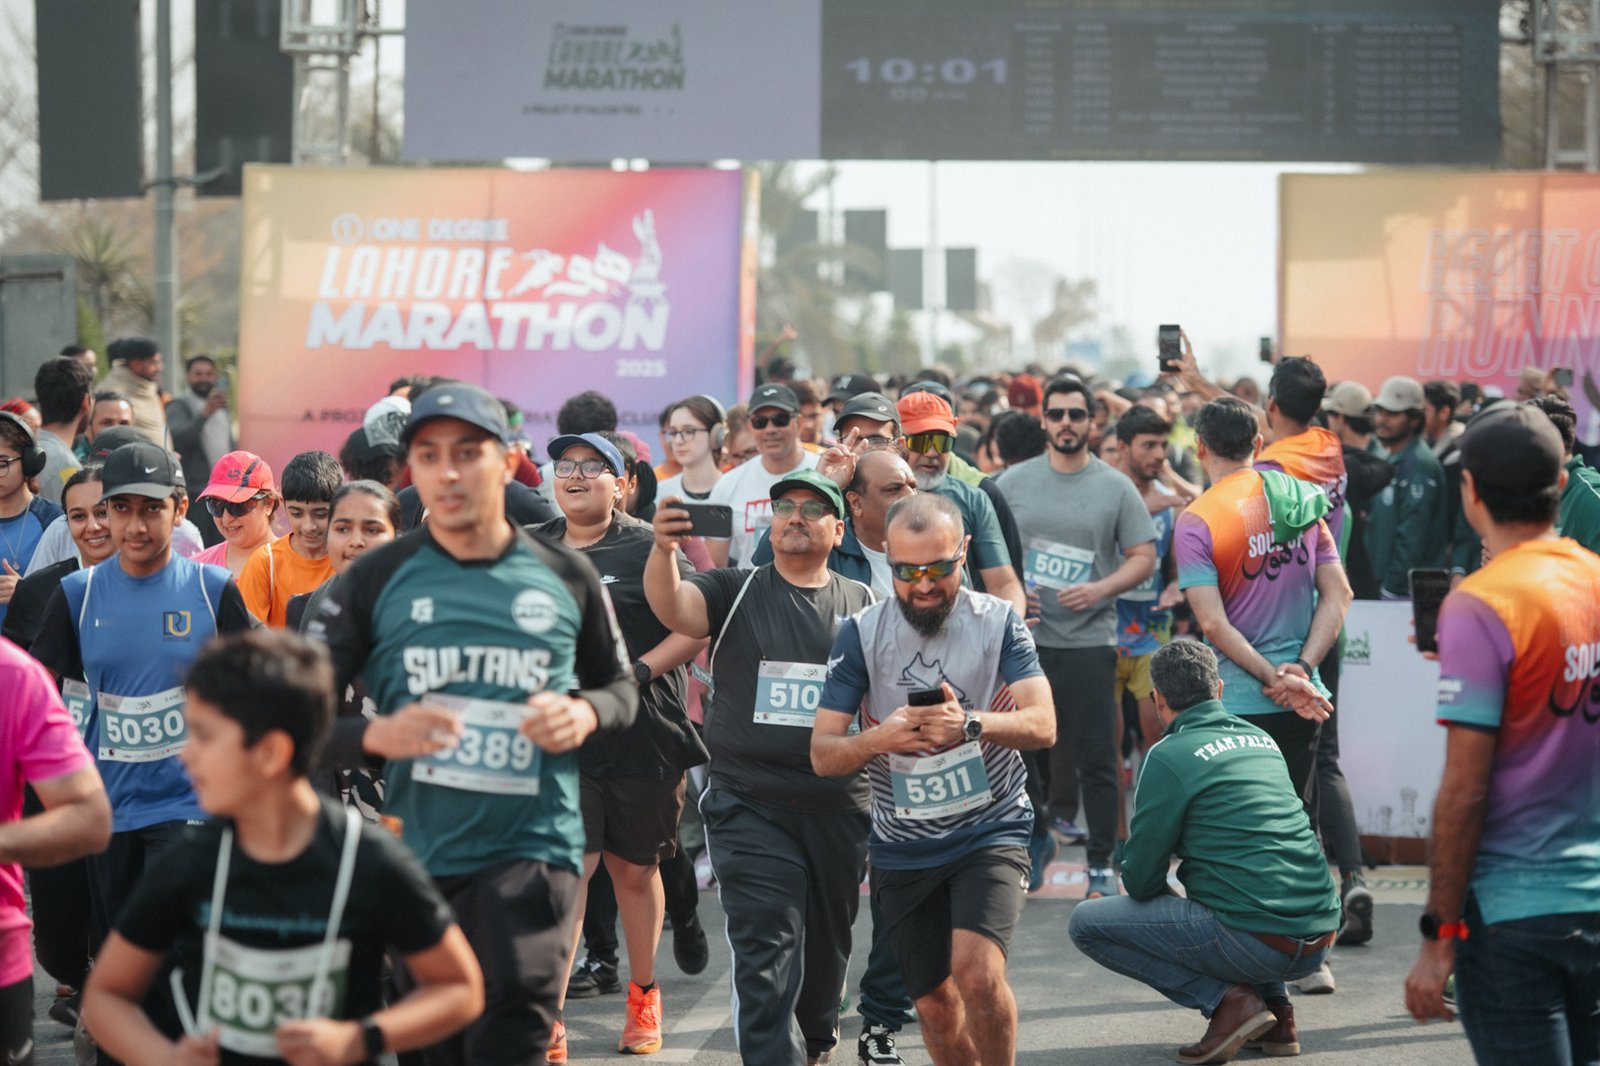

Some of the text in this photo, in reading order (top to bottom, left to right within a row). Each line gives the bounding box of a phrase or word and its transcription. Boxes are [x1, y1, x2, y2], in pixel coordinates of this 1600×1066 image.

[543, 67, 687, 91] MARATHON
[843, 57, 1009, 84] 10:01
[427, 218, 508, 241] DEGREE
[317, 245, 514, 300] LAHORE
[305, 301, 672, 351] MARATHON
[615, 358, 667, 377] 2025
[1034, 553, 1084, 581] 5017
[402, 646, 552, 696] SULTANS
[769, 682, 824, 710] 510
[105, 708, 185, 746] 5030
[1193, 736, 1237, 762] TEAM
[905, 766, 972, 804] 5311
